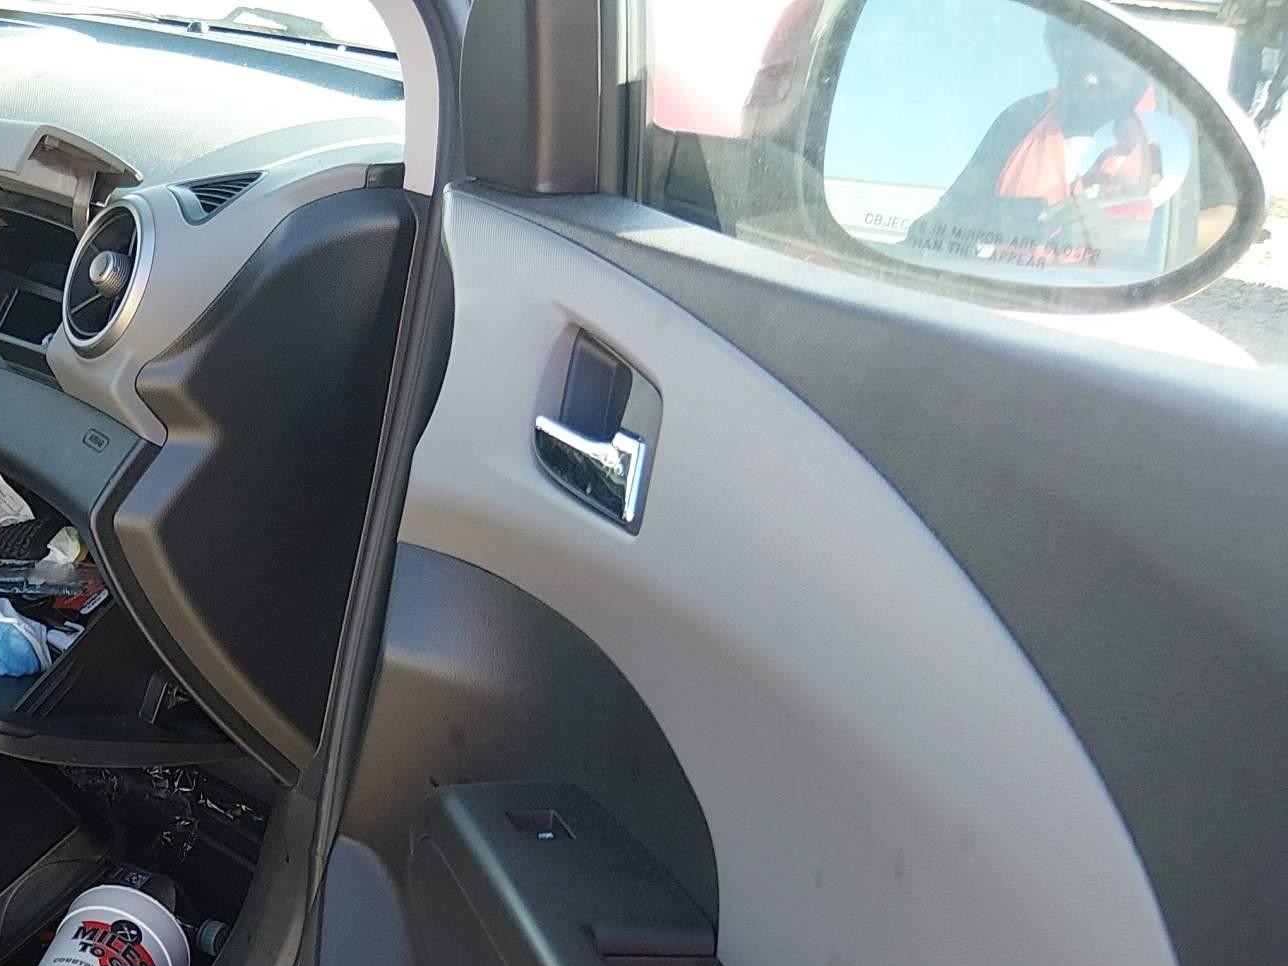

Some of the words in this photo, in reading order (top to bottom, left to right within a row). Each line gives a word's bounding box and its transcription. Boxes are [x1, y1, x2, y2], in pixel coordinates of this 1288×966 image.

[864, 211, 926, 234] OBJECS
[951, 222, 1004, 246] MIRROR
[989, 249, 1047, 271] APPEAR
[78, 941, 105, 958] TO
